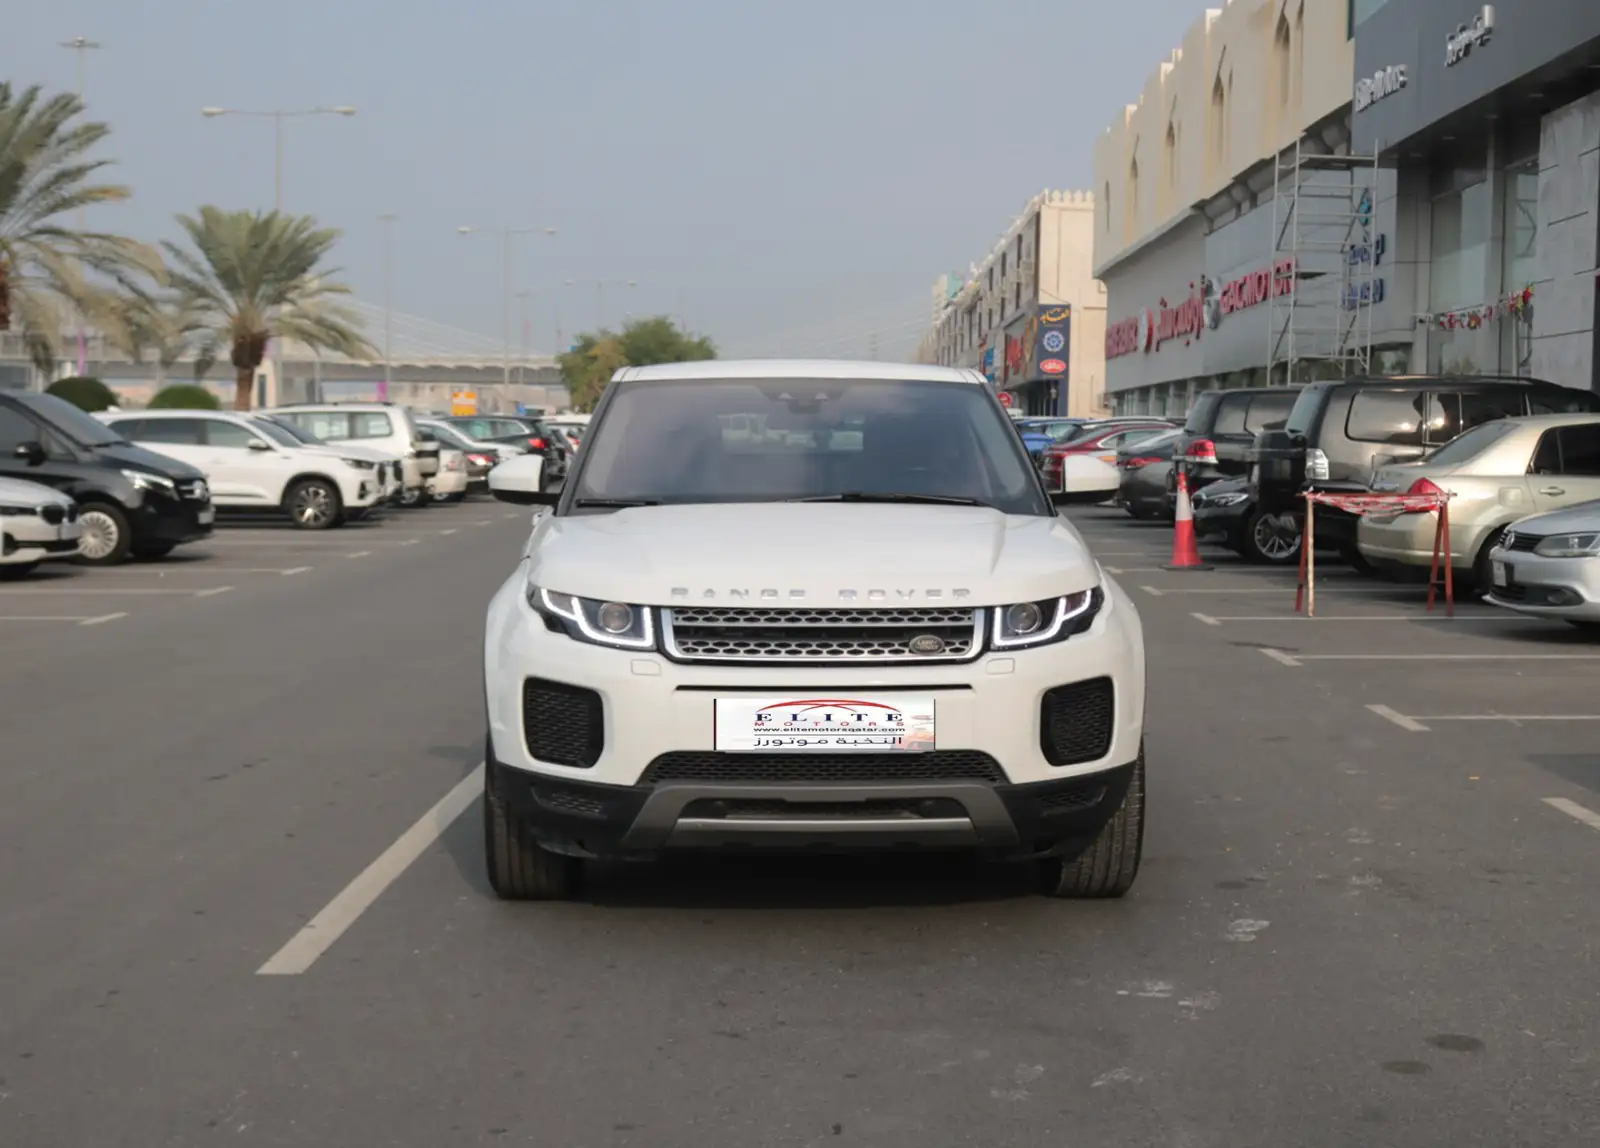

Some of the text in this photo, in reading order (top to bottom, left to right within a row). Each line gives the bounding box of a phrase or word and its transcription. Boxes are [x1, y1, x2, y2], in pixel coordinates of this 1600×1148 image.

[671, 587, 971, 600] RANGE ROVER
[755, 713, 903, 721] ELITE
[753, 736, 902, 746] النخبة موتورز
